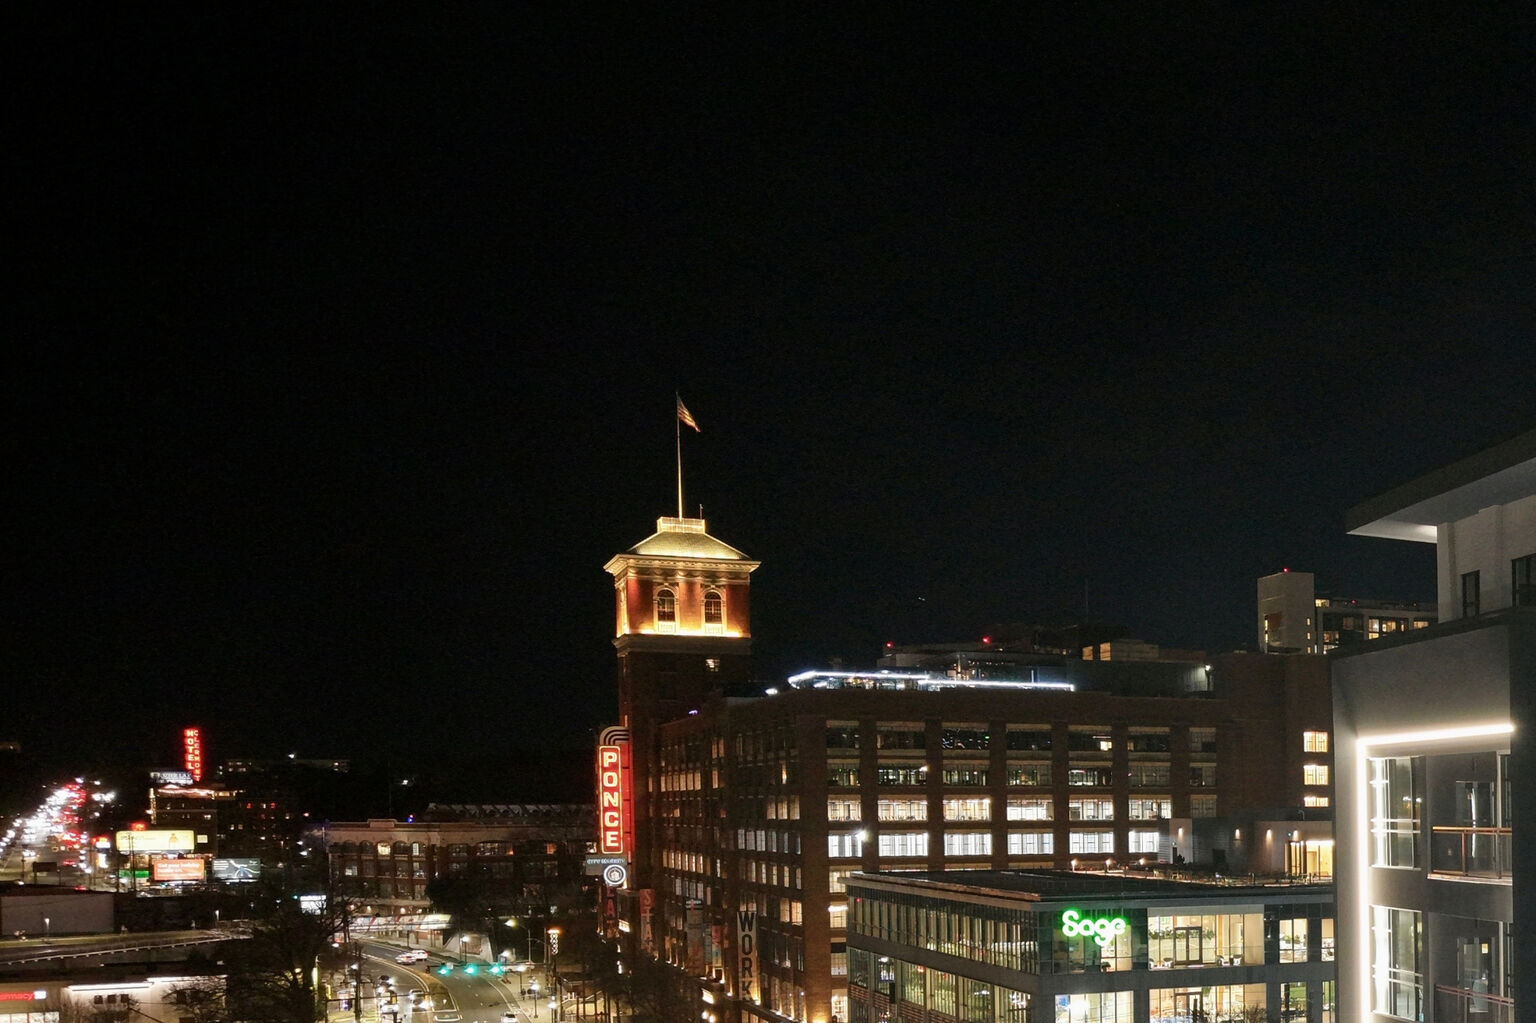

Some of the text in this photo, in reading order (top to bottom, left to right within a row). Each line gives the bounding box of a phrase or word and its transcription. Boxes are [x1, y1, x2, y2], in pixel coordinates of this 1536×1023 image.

[186, 729, 194, 770] HOTEL
[602, 751, 619, 847] PONCE
[738, 911, 755, 1000] WORK
[1062, 910, 1126, 947] Sage
